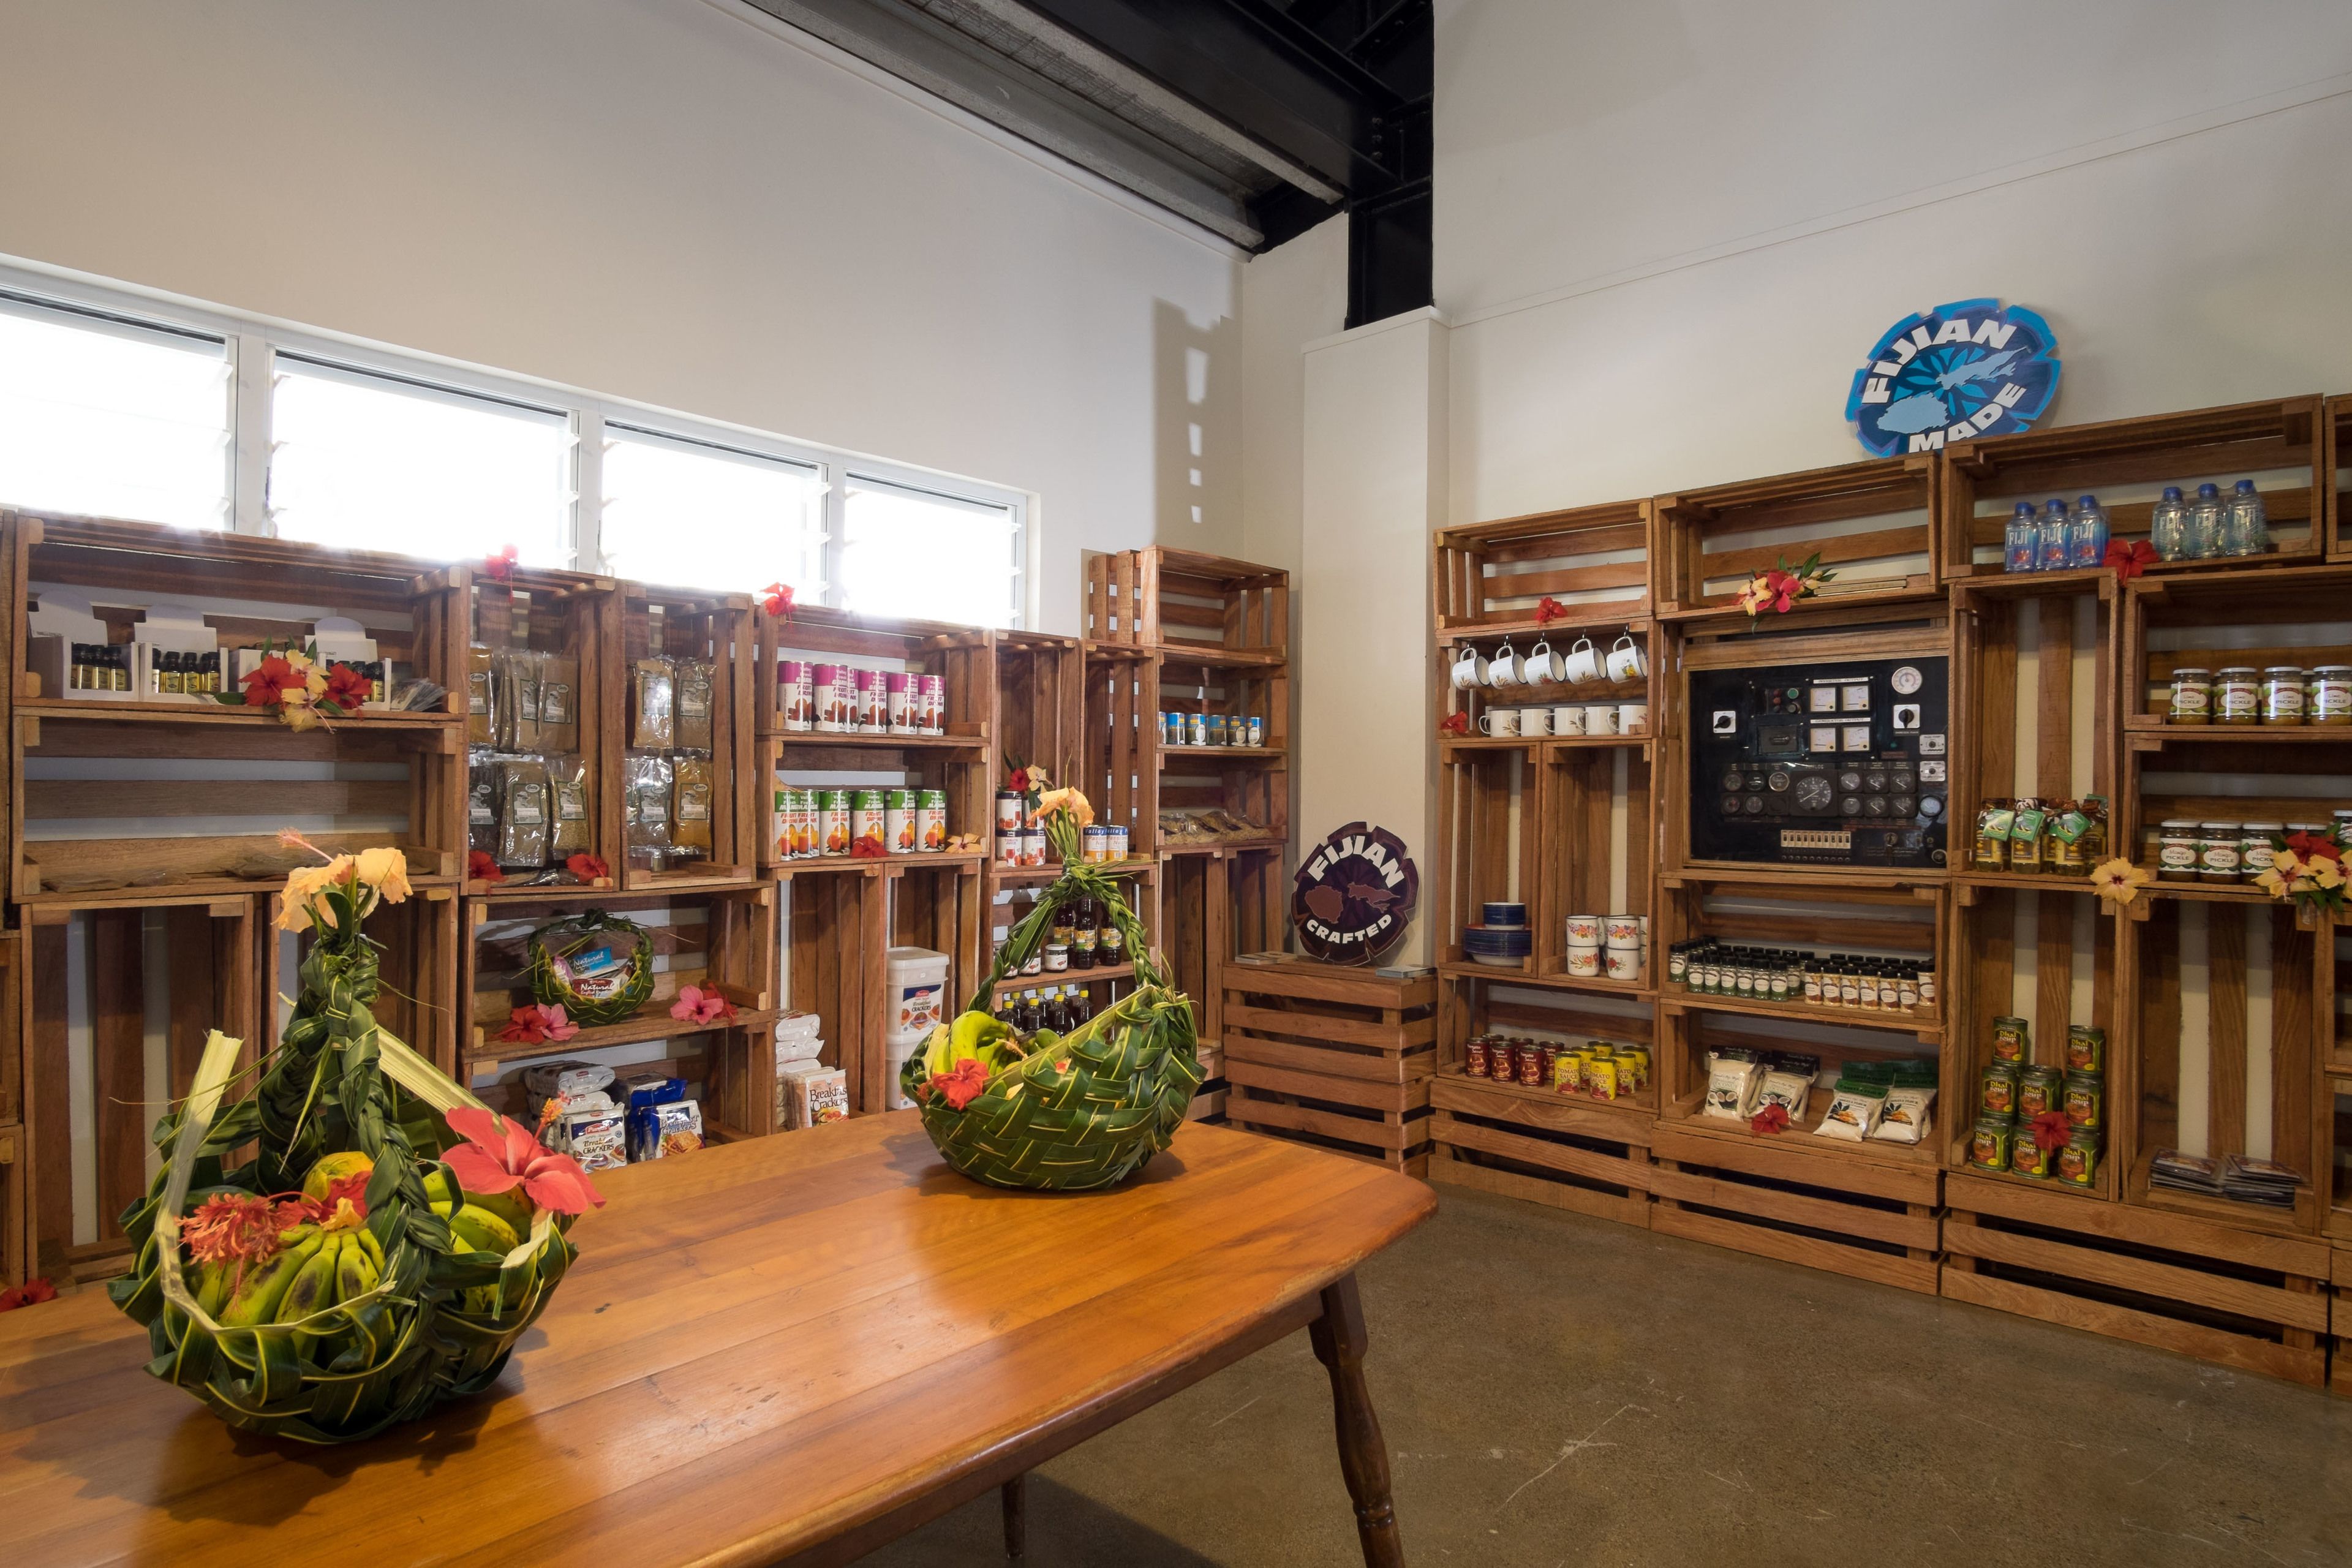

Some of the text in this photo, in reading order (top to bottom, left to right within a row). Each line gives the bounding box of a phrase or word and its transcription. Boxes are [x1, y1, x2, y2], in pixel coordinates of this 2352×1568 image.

[1862, 319, 2017, 404] FIJIAN
[1909, 382, 2027, 453] MADE
[2008, 531, 2028, 546] FIJI
[2040, 528, 2062, 543] FIJI
[2073, 525, 2094, 540] FIJI
[1306, 835, 1404, 888] FIJIAN
[1306, 914, 1392, 944] CRAFTED
[573, 951, 605, 967] Natural
[812, 1096, 848, 1112] Crackers
[1975, 1131, 1991, 1140] Dhal
[582, 1144, 614, 1155] CRACKERS
[2063, 1147, 2080, 1156] Dhal
